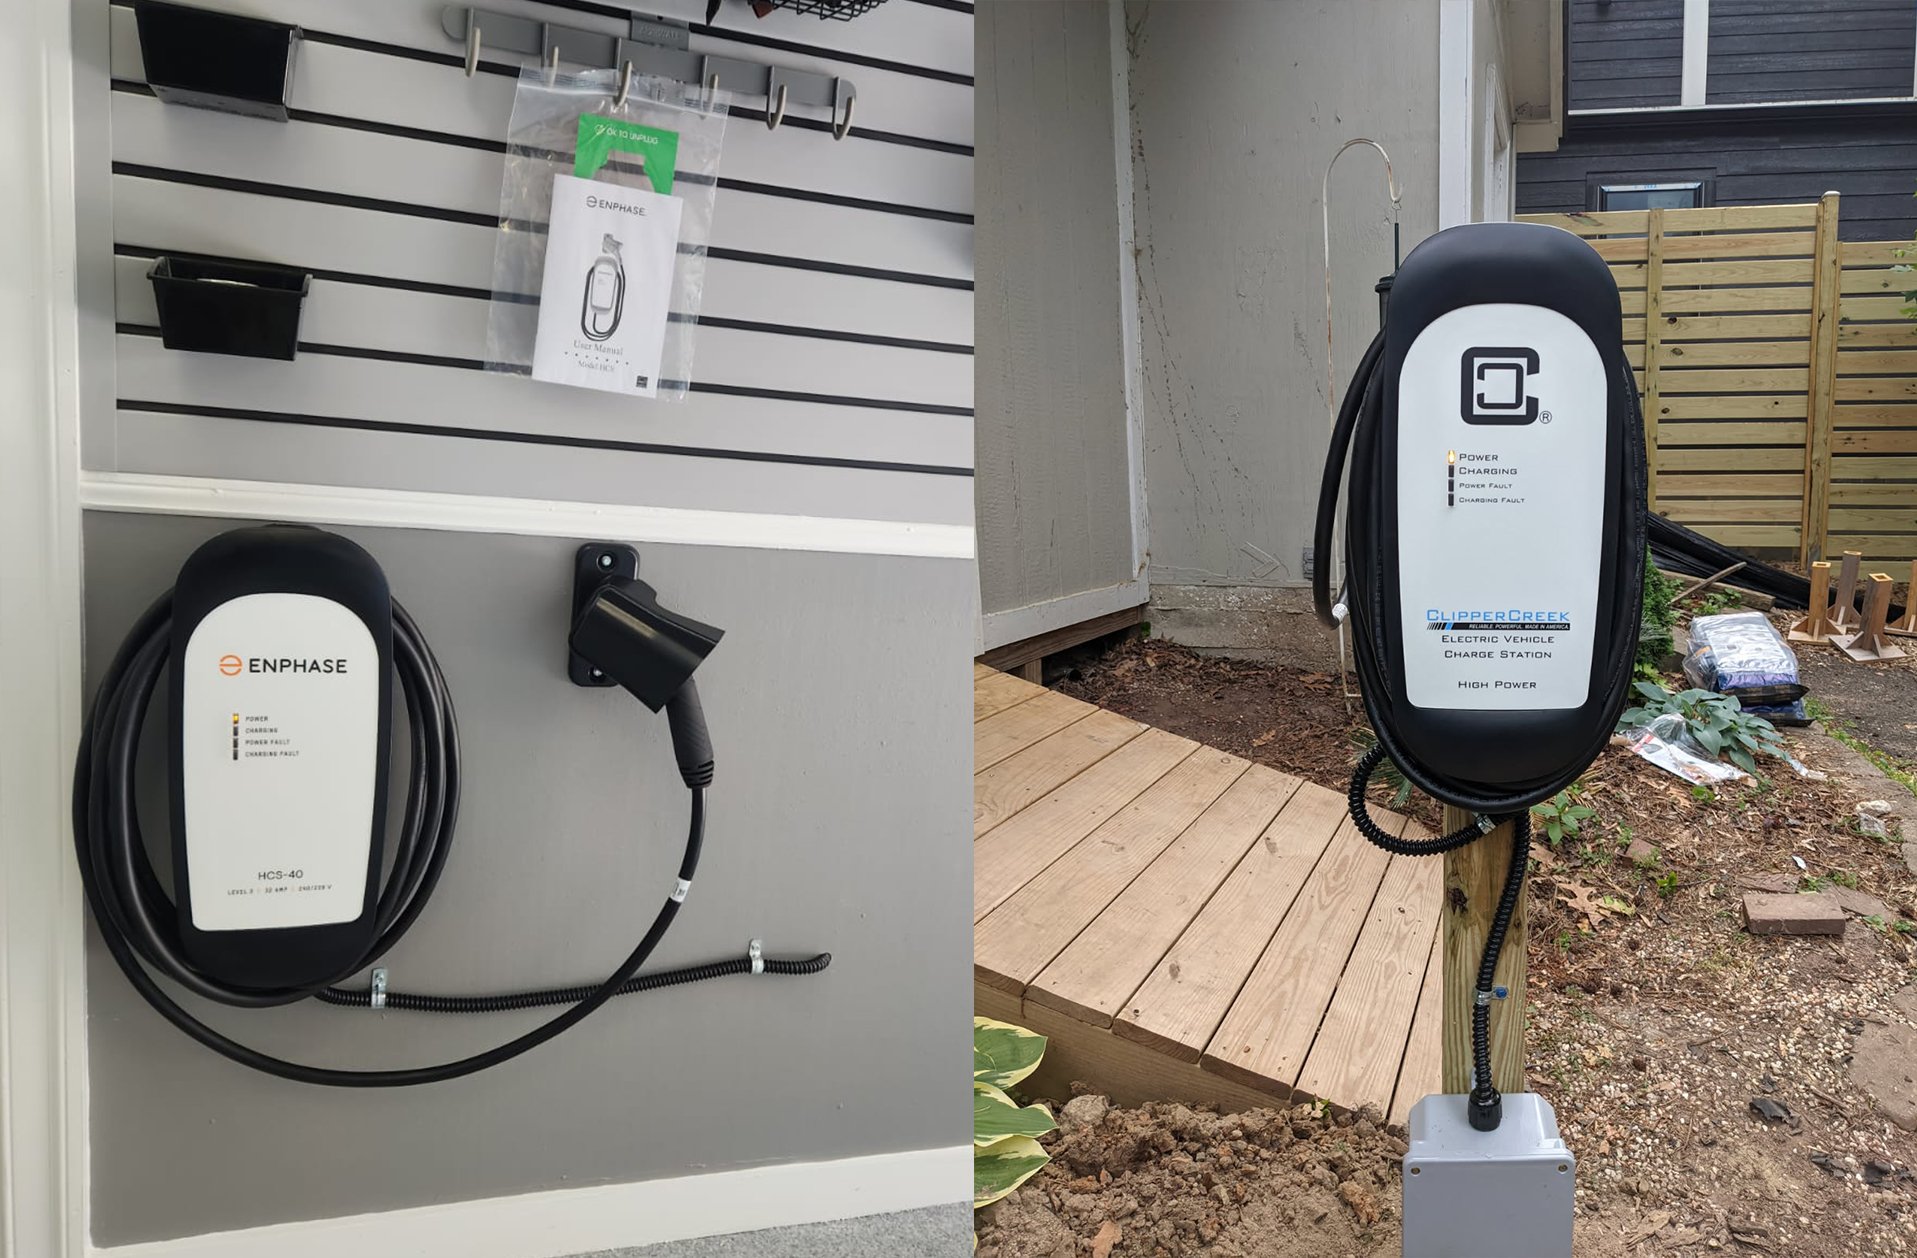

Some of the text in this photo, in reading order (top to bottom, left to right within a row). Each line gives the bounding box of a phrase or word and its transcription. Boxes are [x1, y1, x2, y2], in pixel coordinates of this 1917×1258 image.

[599, 199, 647, 217] ENPHASE
[573, 339, 624, 356] User Manual
[249, 658, 348, 674] ENPHASE
[258, 869, 304, 881] HCS-40
